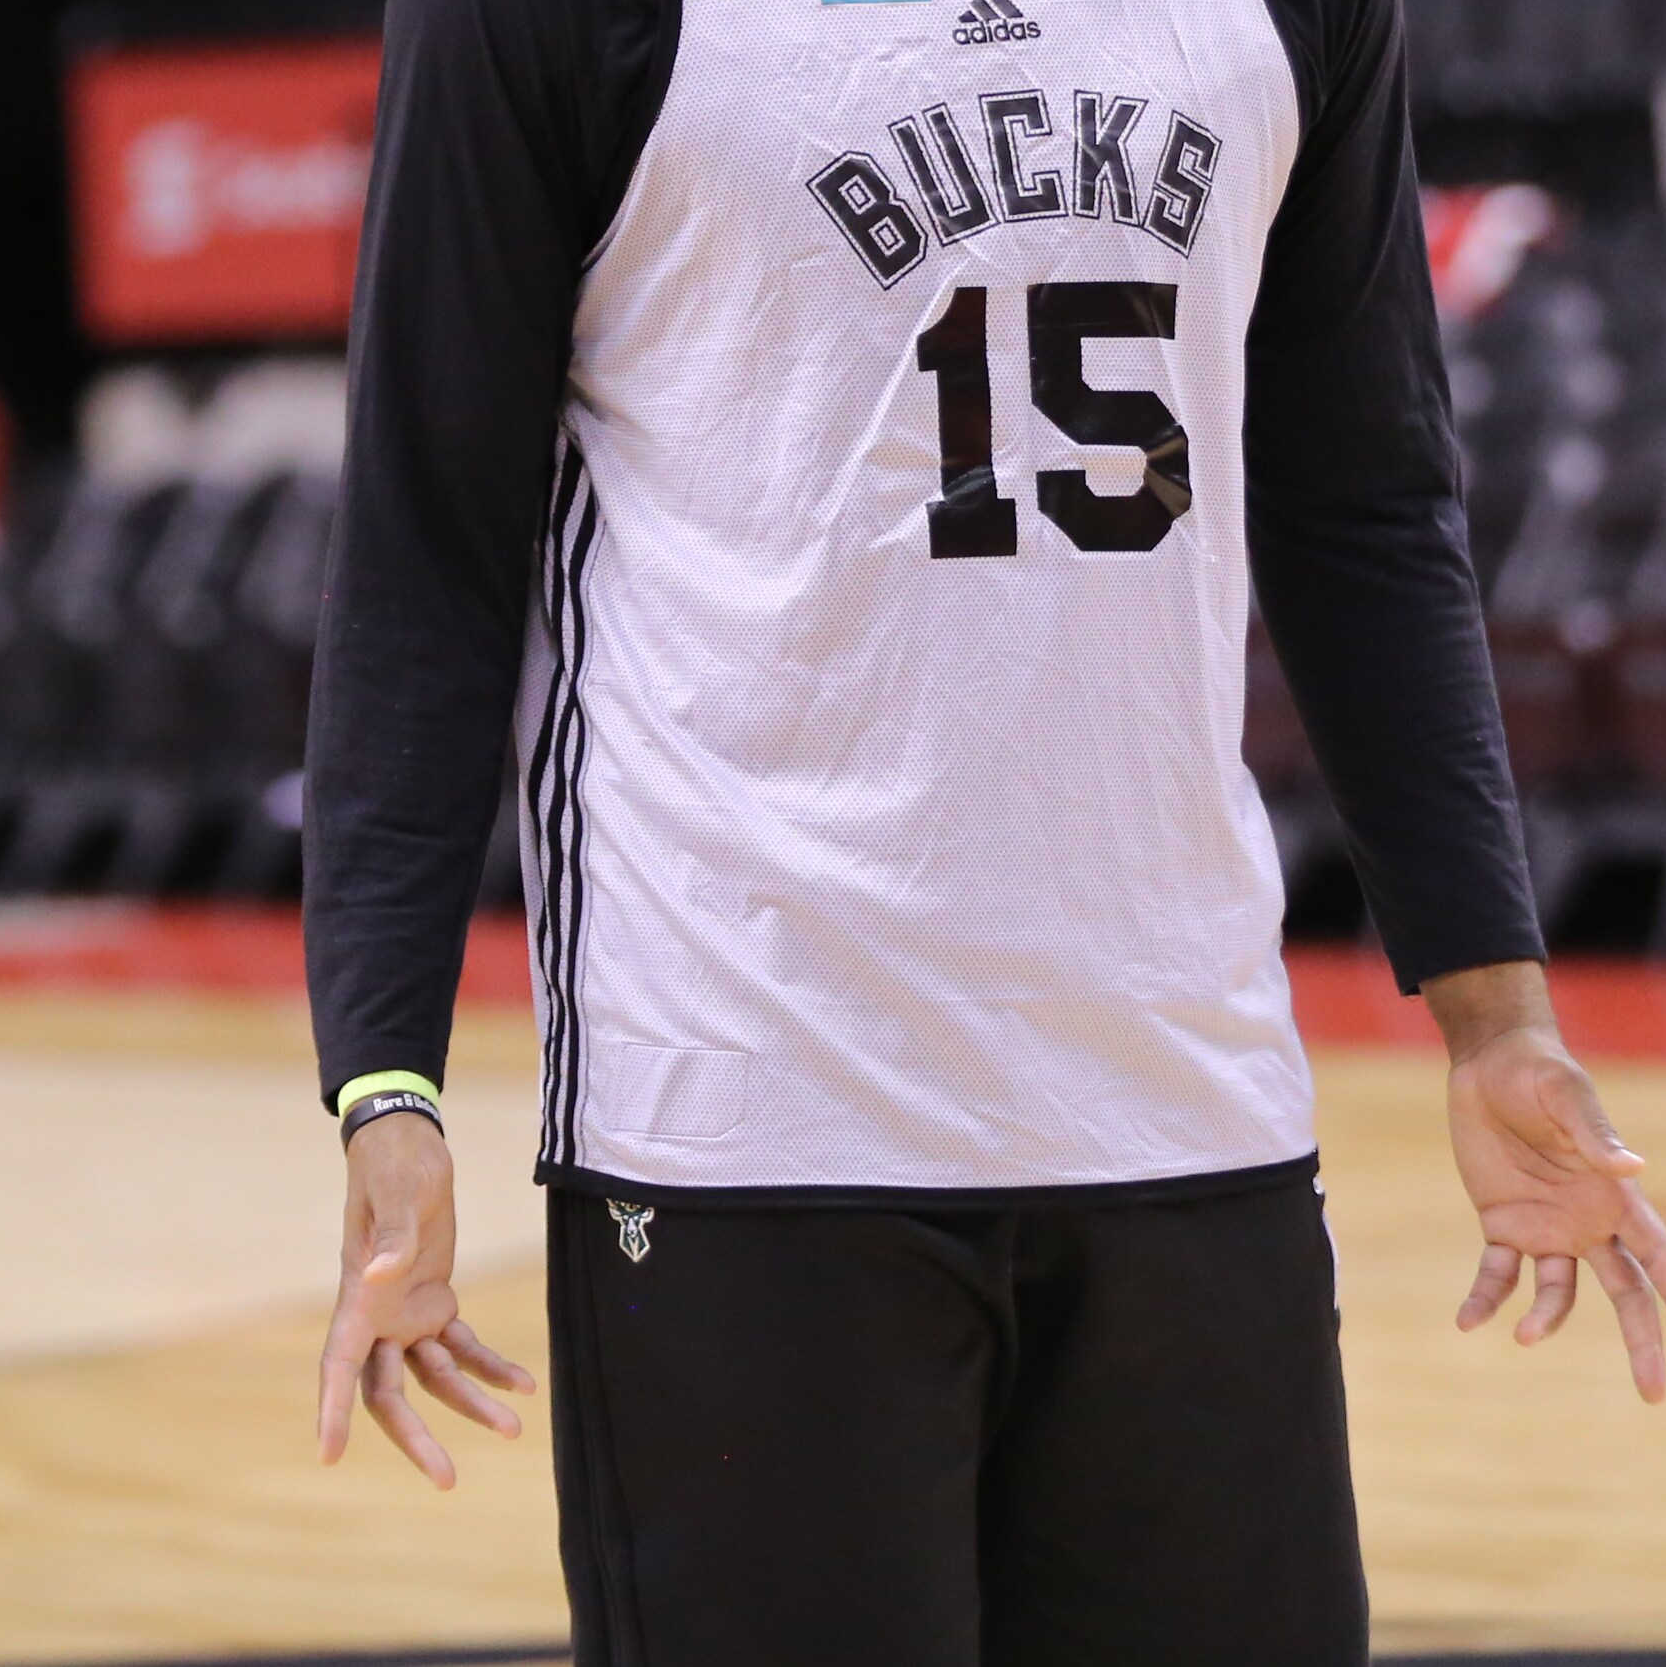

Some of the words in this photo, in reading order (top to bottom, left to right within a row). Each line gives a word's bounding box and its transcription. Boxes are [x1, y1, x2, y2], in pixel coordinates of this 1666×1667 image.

[952, 18, 1041, 45] adidas
[806, 88, 1222, 291] BUCKS
[917, 282, 1192, 559] 15
[373, 1096, 403, 1112] Rare
